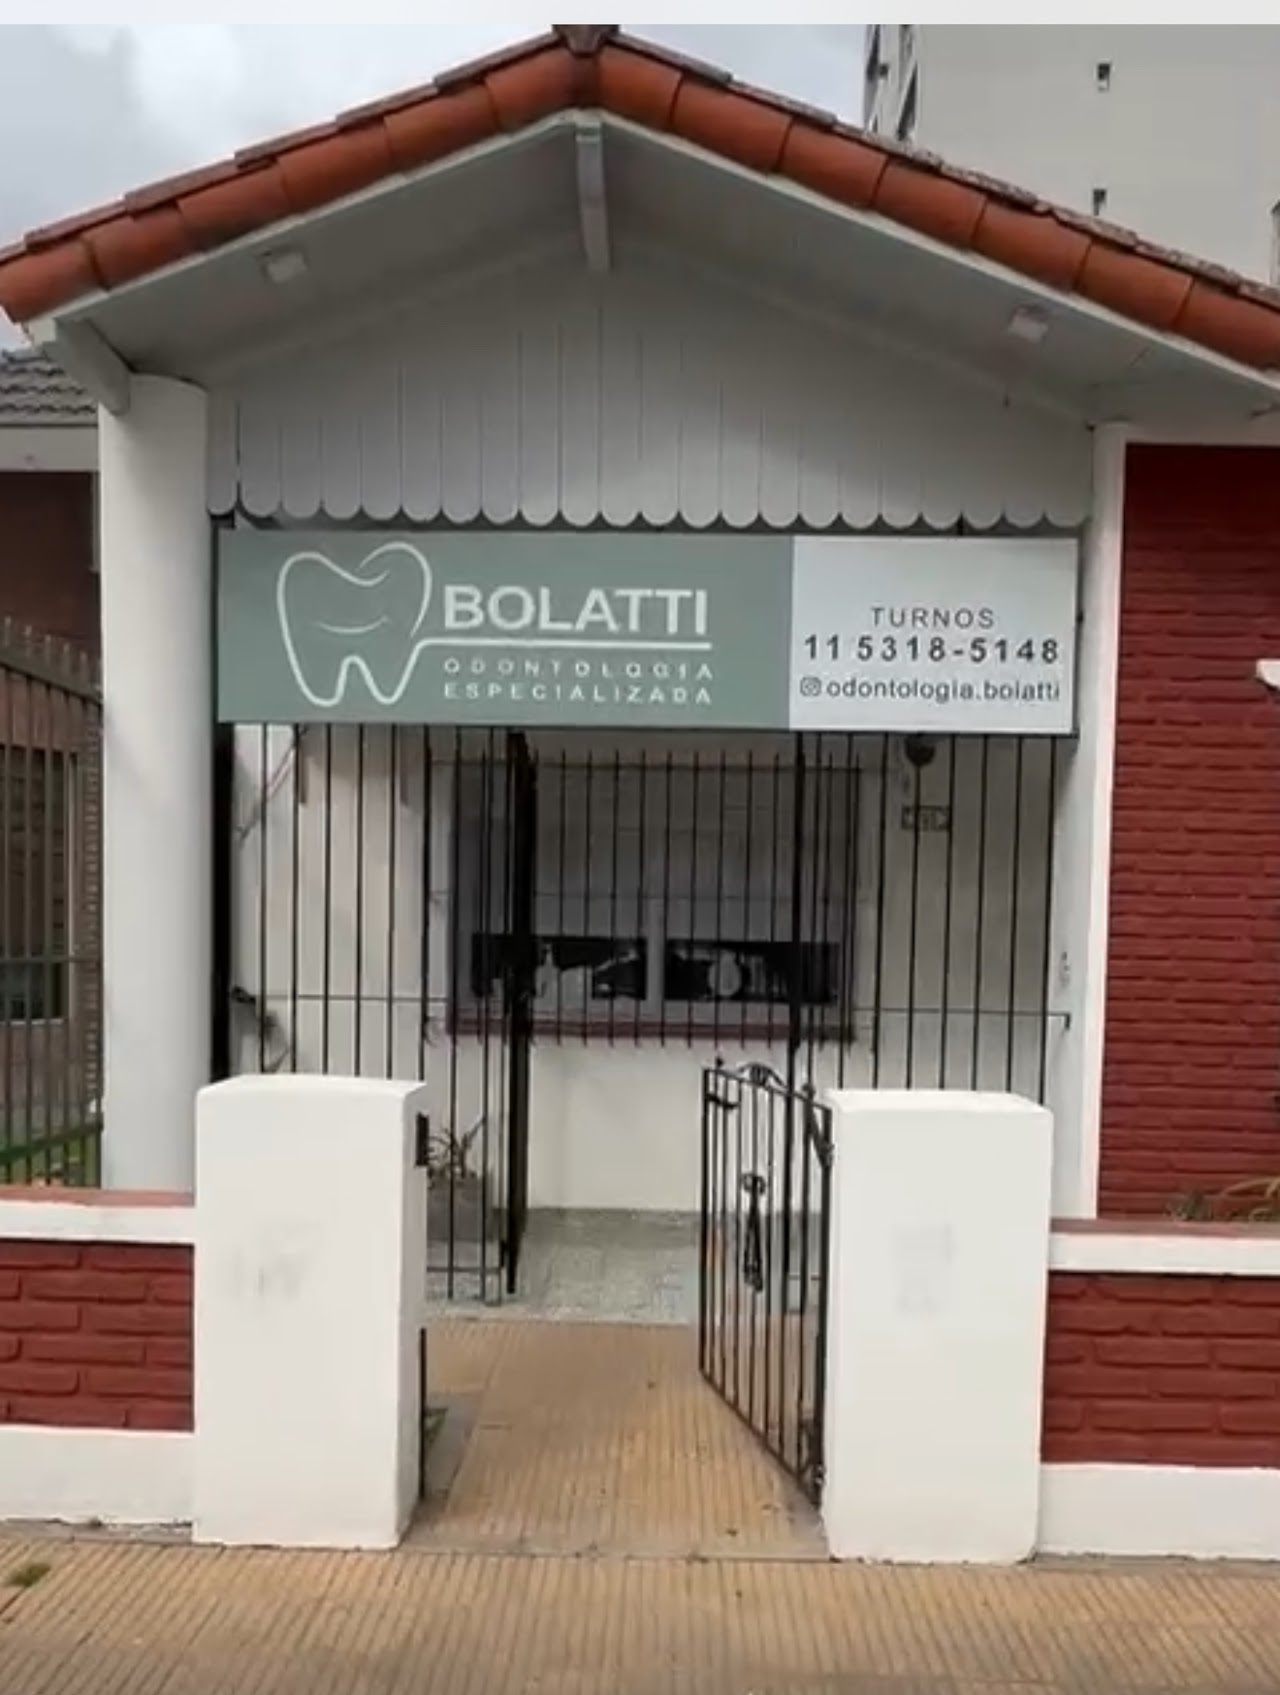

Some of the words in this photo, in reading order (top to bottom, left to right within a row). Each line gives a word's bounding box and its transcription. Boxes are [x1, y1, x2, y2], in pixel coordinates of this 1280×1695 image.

[444, 585, 707, 636] BOLATTI
[870, 606, 995, 630] TURNOS
[804, 633, 840, 661] 11
[856, 635, 1059, 664] 5318-5148
[444, 657, 713, 681] ODONTOLOGIA
[444, 682, 712, 705] ESPECIALIZADA
[826, 676, 1060, 705] odontologia.bolatti
